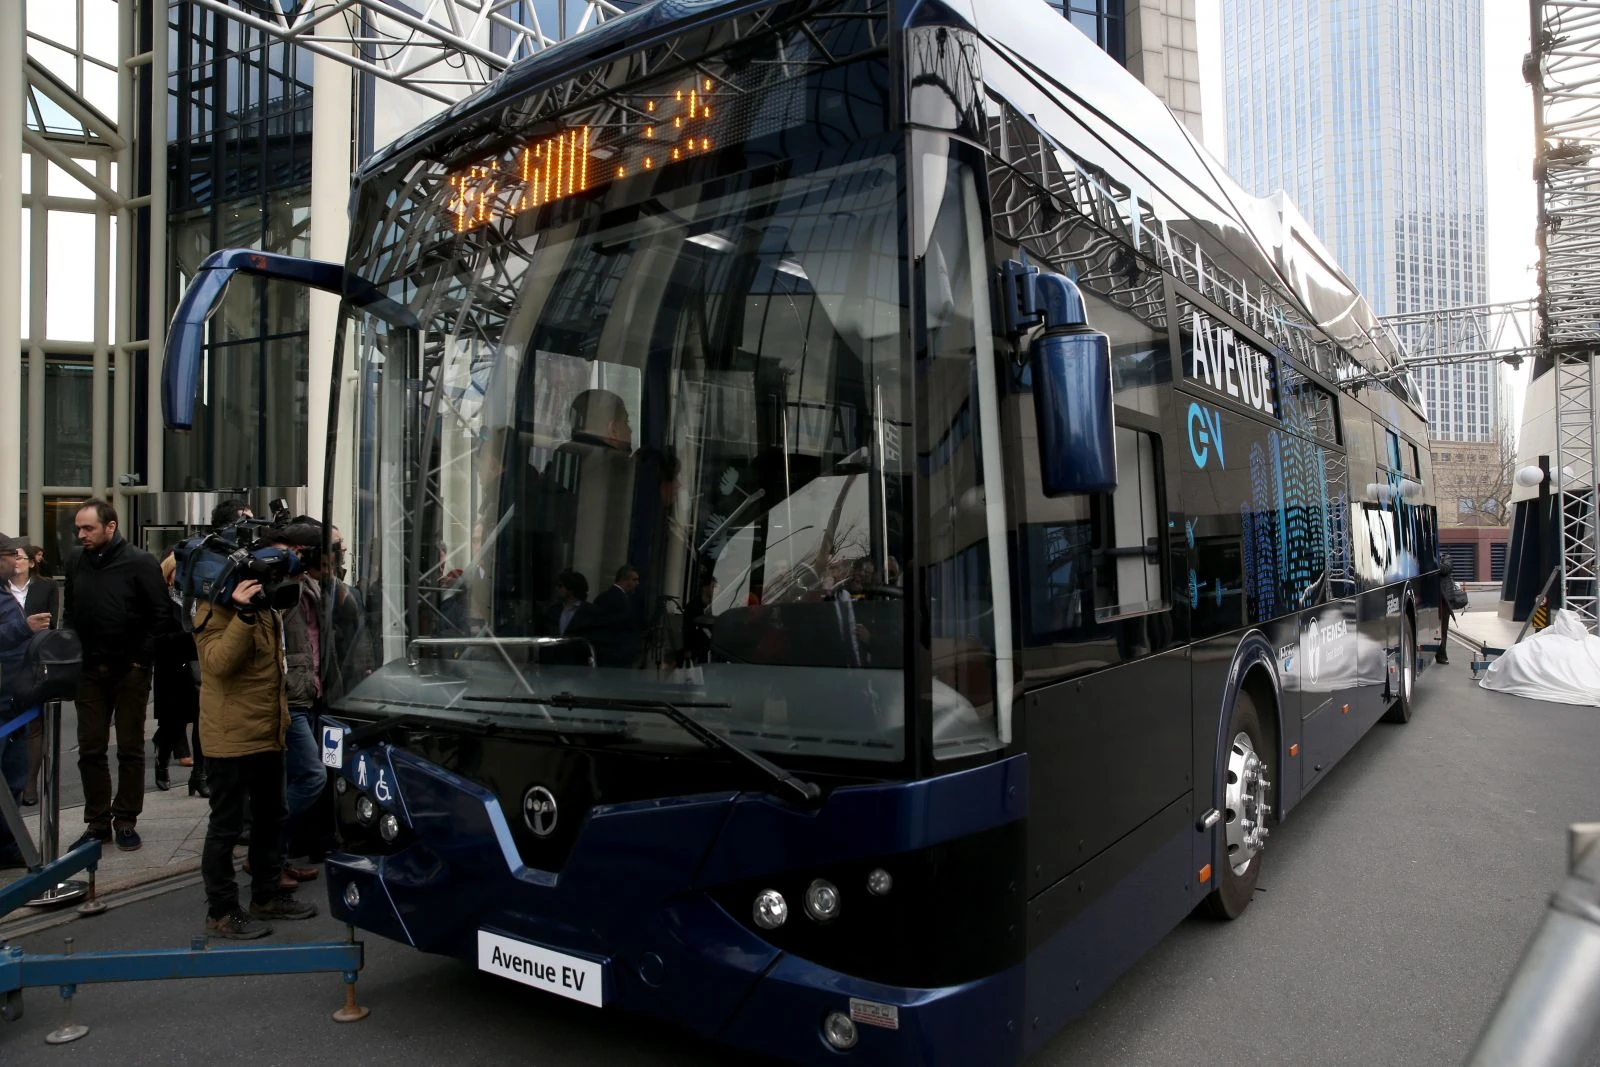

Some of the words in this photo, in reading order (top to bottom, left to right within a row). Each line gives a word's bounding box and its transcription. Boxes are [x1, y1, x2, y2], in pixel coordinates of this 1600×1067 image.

[1192, 311, 1274, 414] AVENUE
[1320, 619, 1348, 645] TEMSA
[491, 945, 556, 983] Avenue
[562, 965, 585, 991] EV
